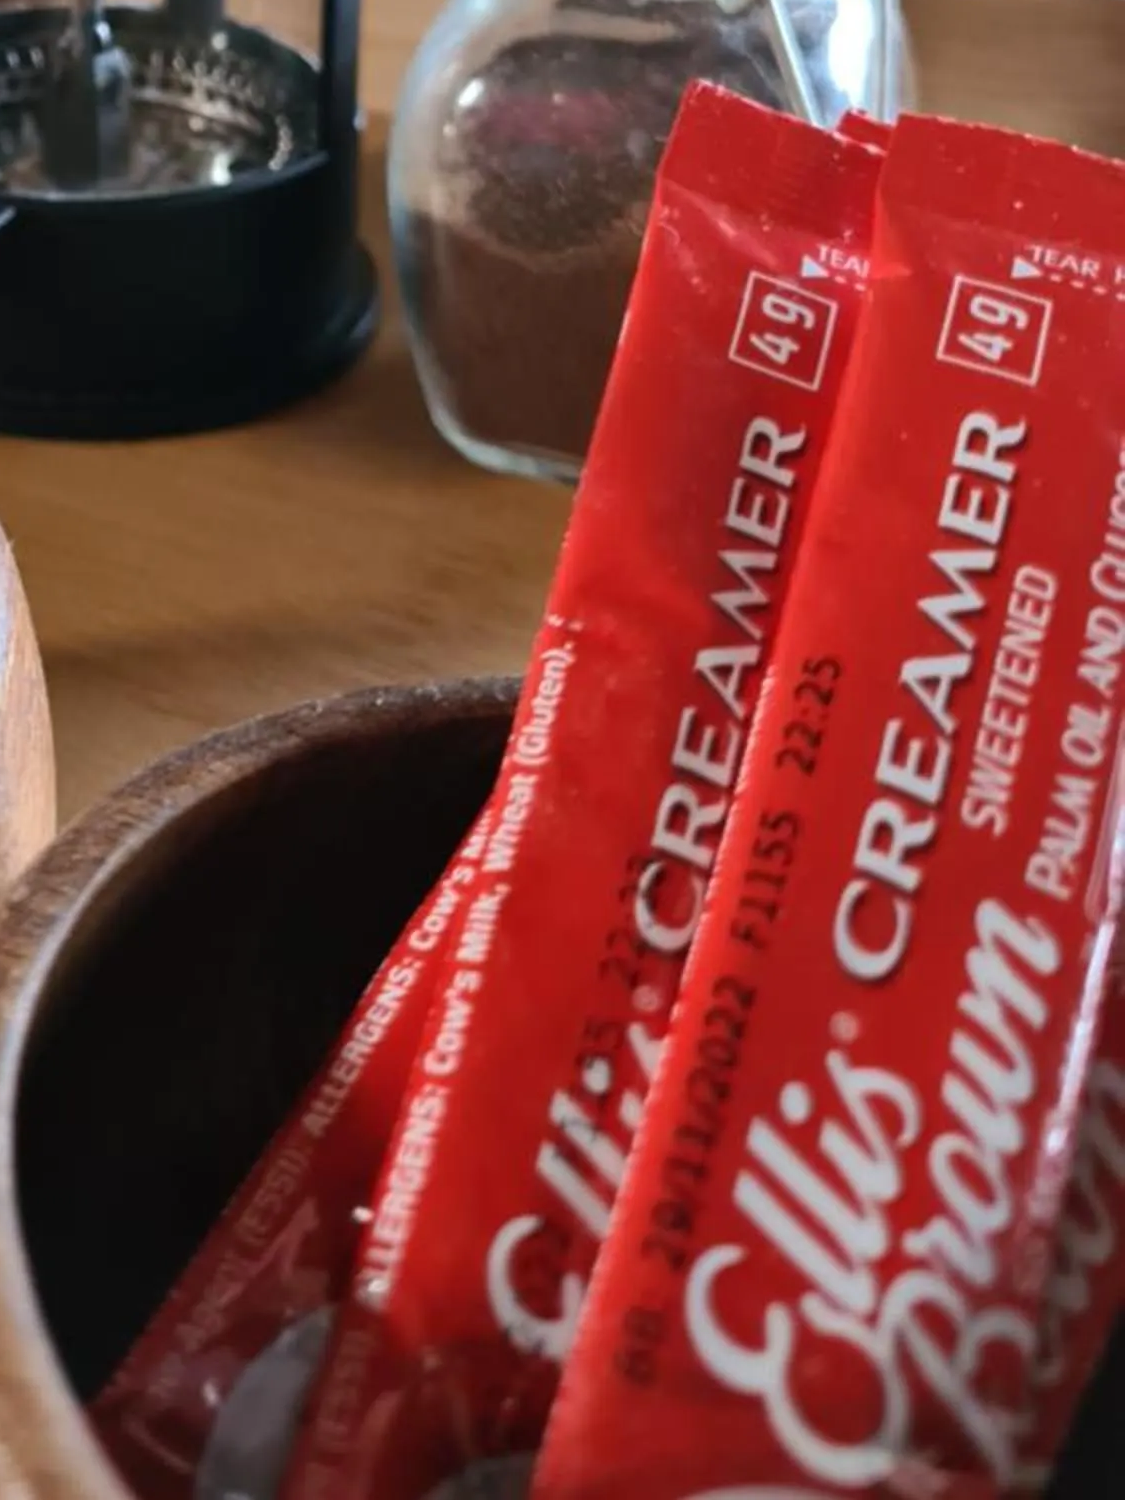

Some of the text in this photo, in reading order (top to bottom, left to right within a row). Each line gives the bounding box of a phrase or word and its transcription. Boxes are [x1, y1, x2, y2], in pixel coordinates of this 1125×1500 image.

[1028, 245, 1100, 279] TEAR
[512, 641, 576, 767] (Gluten).
[633, 415, 808, 953] CREAMER
[774, 652, 842, 777] 22:25
[833, 410, 1027, 982] CREAMER
[961, 562, 1058, 838] SWEETENED
[1078, 606, 1125, 697] AND
[1061, 703, 1112, 768] OIL
[481, 773, 539, 873] Wheat
[1024, 774, 1097, 900] PALM
[455, 882, 512, 962] Milk,
[301, 957, 424, 1139] ALLERGENS:
[408, 865, 476, 952] Cow's
[422, 968, 482, 1077] Cow's
[356, 1084, 450, 1311] ALLERGENS:
[873, 898, 1062, 1486] Brown
[684, 1049, 923, 1486] Ellis
